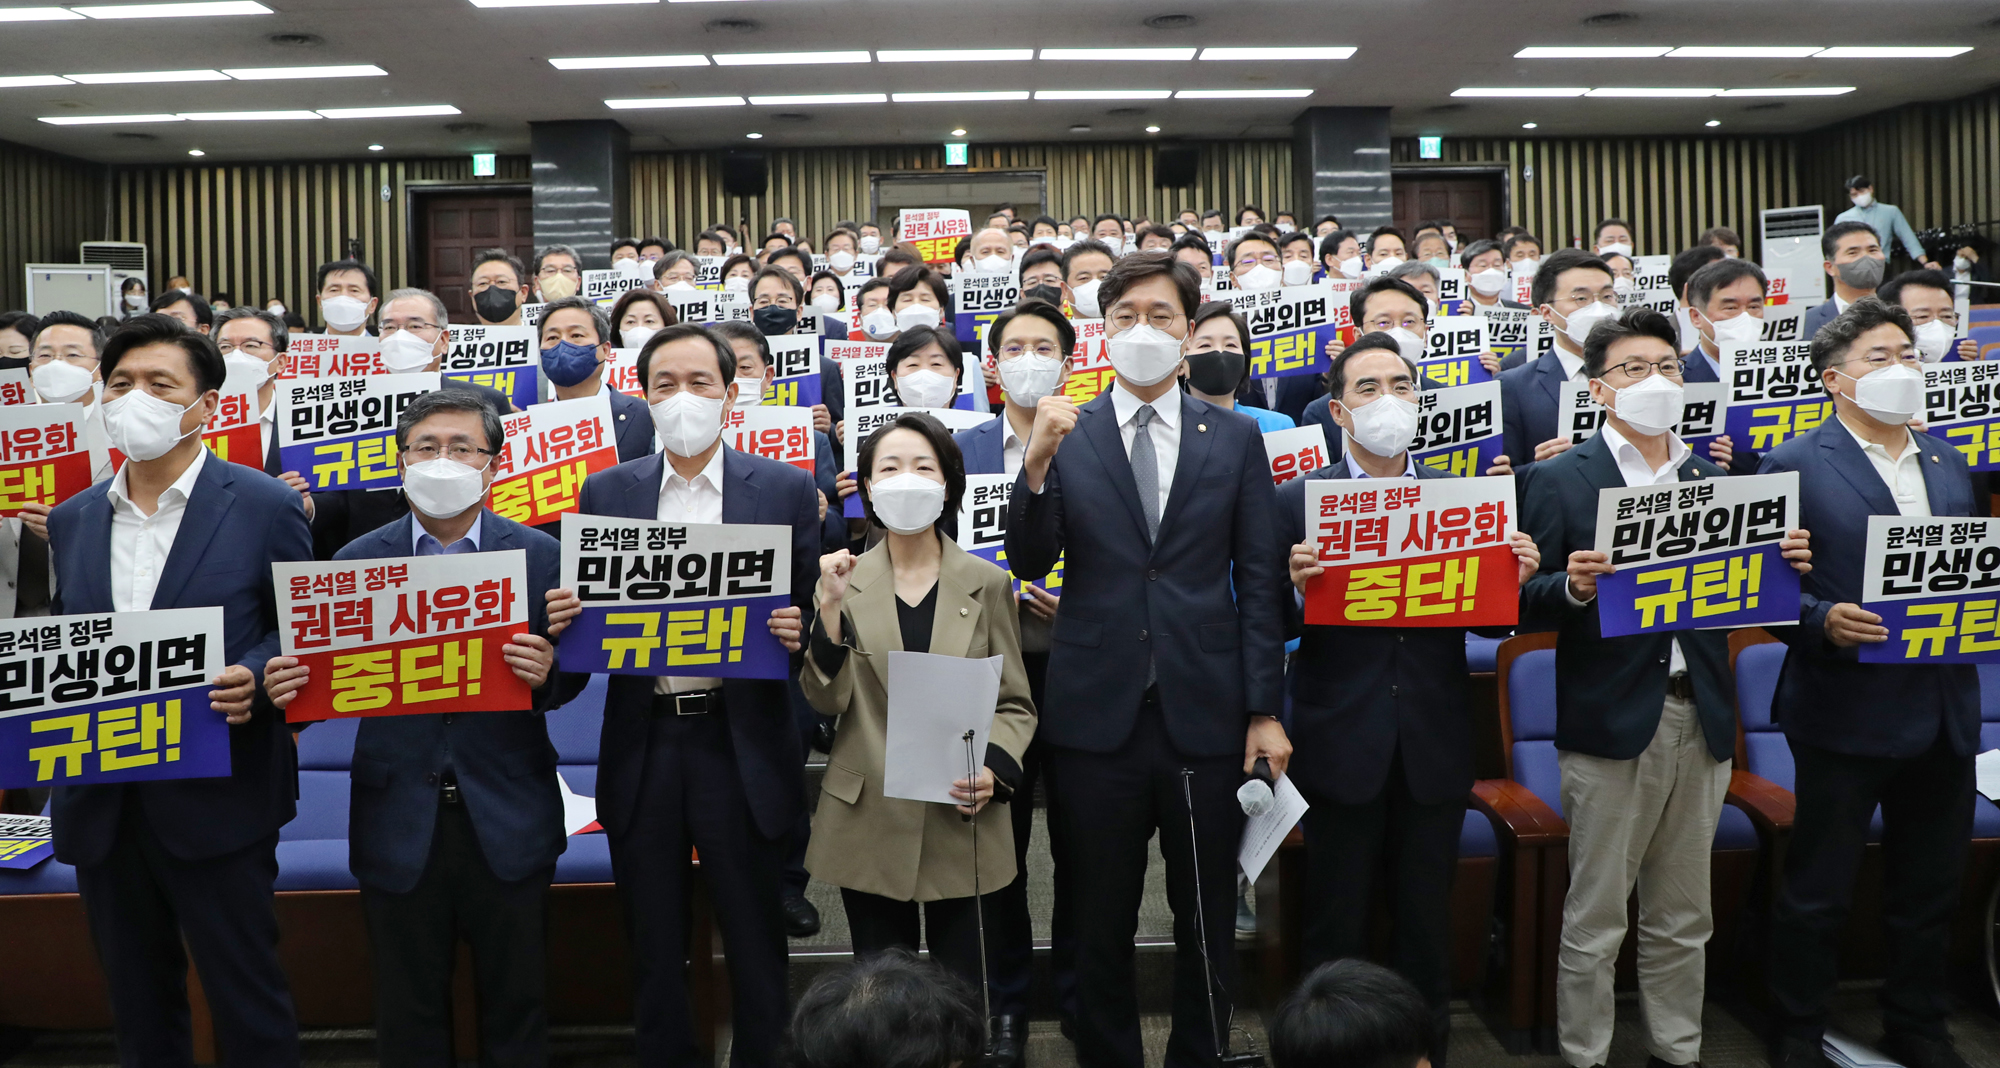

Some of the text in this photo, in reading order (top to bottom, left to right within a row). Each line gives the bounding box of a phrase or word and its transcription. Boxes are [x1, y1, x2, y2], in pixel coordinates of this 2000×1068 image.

[904, 219, 968, 239] 권력 사유화
[905, 211, 940, 222] 윤석열 정부
[915, 236, 963, 262] 중단
[963, 277, 989, 289] 윤석열
[992, 276, 1010, 288] 정부
[1260, 290, 1282, 305] 정부
[1332, 283, 1347, 292] 석열
[1517, 287, 1530, 303] 권
[733, 308, 749, 319] 윤석
[1246, 298, 1326, 335] 생외면
[286, 338, 339, 352] 석열 정부
[464, 328, 485, 341] 정부
[1421, 329, 1480, 359] 외면
[440, 339, 529, 370] 생외면
[831, 346, 884, 359] 윤석열 정부
[1073, 341, 1088, 366] 력
[1734, 347, 1777, 366] 윤석열
[608, 365, 643, 390] 사유
[1420, 360, 1469, 387] 탄!
[1733, 363, 1825, 402] 민생외
[1925, 363, 1999, 388] 윤석열 정부
[291, 378, 367, 405] 윤석열 정부
[504, 415, 532, 438] 정부
[1749, 401, 1833, 449] 규탄
[524, 416, 604, 467] 사유화
[312, 435, 400, 488] 규탄
[1272, 445, 1324, 485] 유화
[0, 464, 55, 510] 단!
[1320, 485, 1421, 517] 윤석열 정부
[1617, 483, 1714, 520] 윤석열 정부
[580, 526, 687, 551] 윤석열 정부
[1317, 501, 1508, 562] 권력 사유화
[1611, 495, 1787, 565] 민생외면
[1887, 521, 1987, 549] 윤석열 정부
[290, 563, 408, 600] 윤석열 정부
[577, 548, 775, 601] 민생외면
[1882, 546, 2000, 596] 민생외
[1344, 556, 1480, 621] 중단!
[1635, 553, 1763, 628] 규탄!
[291, 577, 515, 650] 권력 사유화
[1901, 599, 2000, 658] 규탄
[0, 617, 113, 657] 윤석열 정부
[602, 606, 747, 669] 규탄!
[0, 633, 206, 712] 민생외면
[331, 638, 483, 712] 중단!
[29, 698, 182, 782] 규탄!
